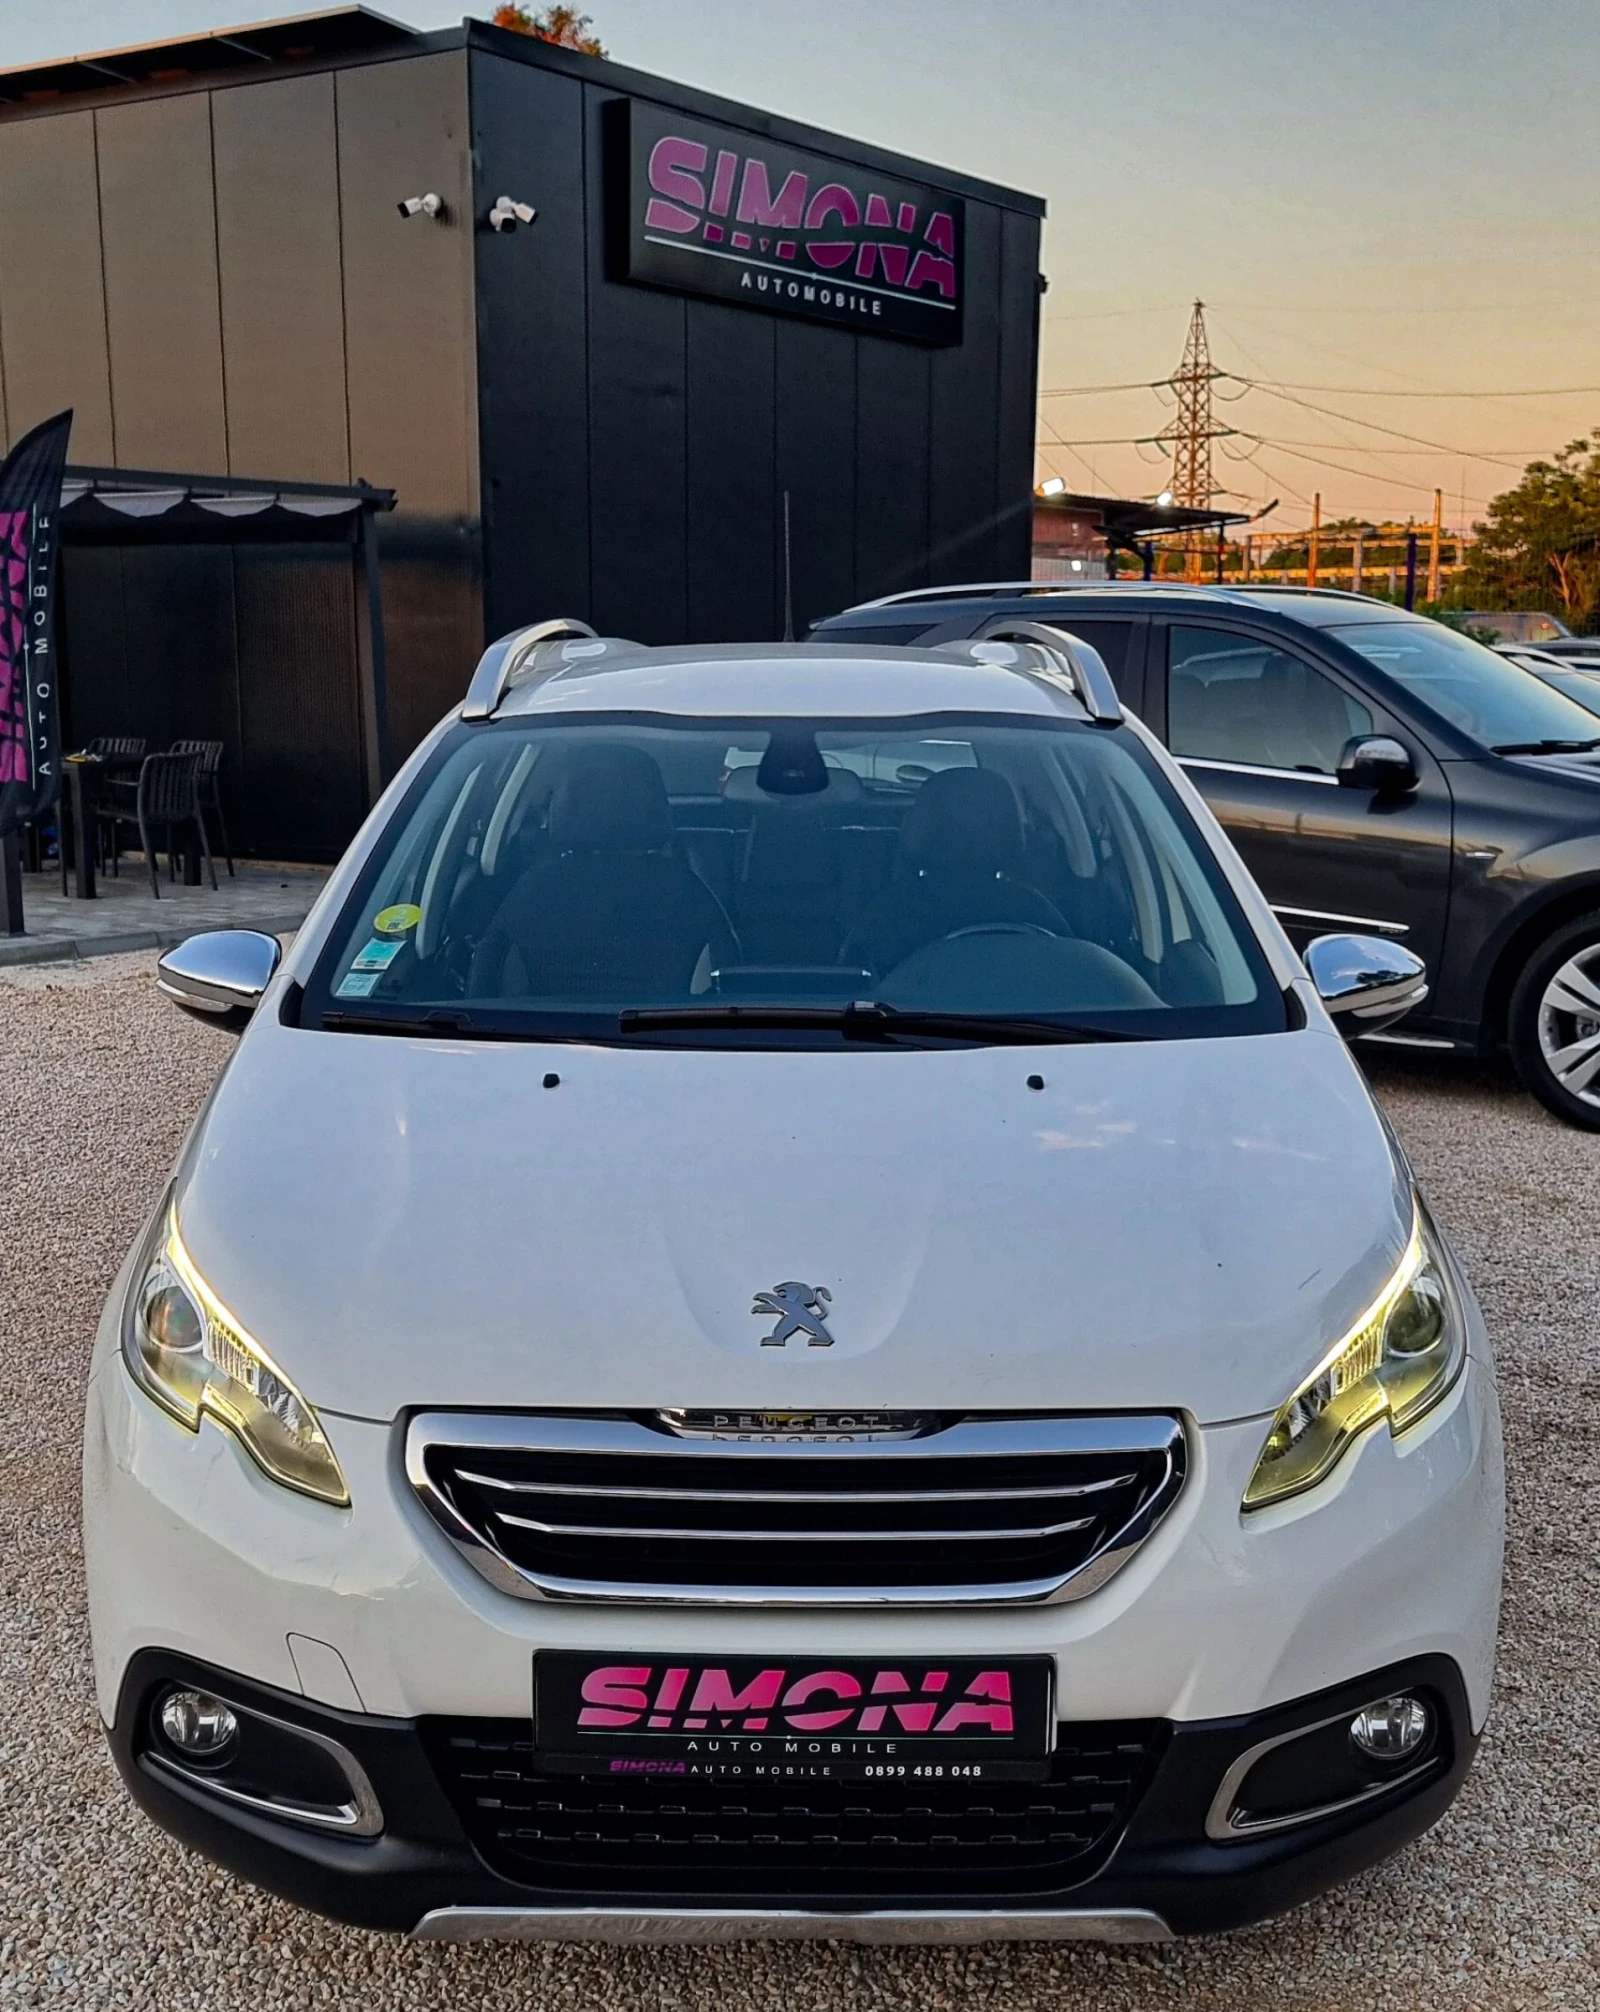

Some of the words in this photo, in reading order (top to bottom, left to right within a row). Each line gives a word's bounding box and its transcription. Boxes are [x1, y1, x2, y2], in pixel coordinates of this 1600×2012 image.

[644, 136, 956, 298] SIMONA
[713, 1414, 879, 1431] PEUGEOT
[577, 1667, 1014, 1731] SIMONA
[609, 1760, 686, 1774] SIMONA
[865, 1766, 905, 1777] 0899
[913, 1766, 943, 1777] 488
[951, 1766, 981, 1777] 048
